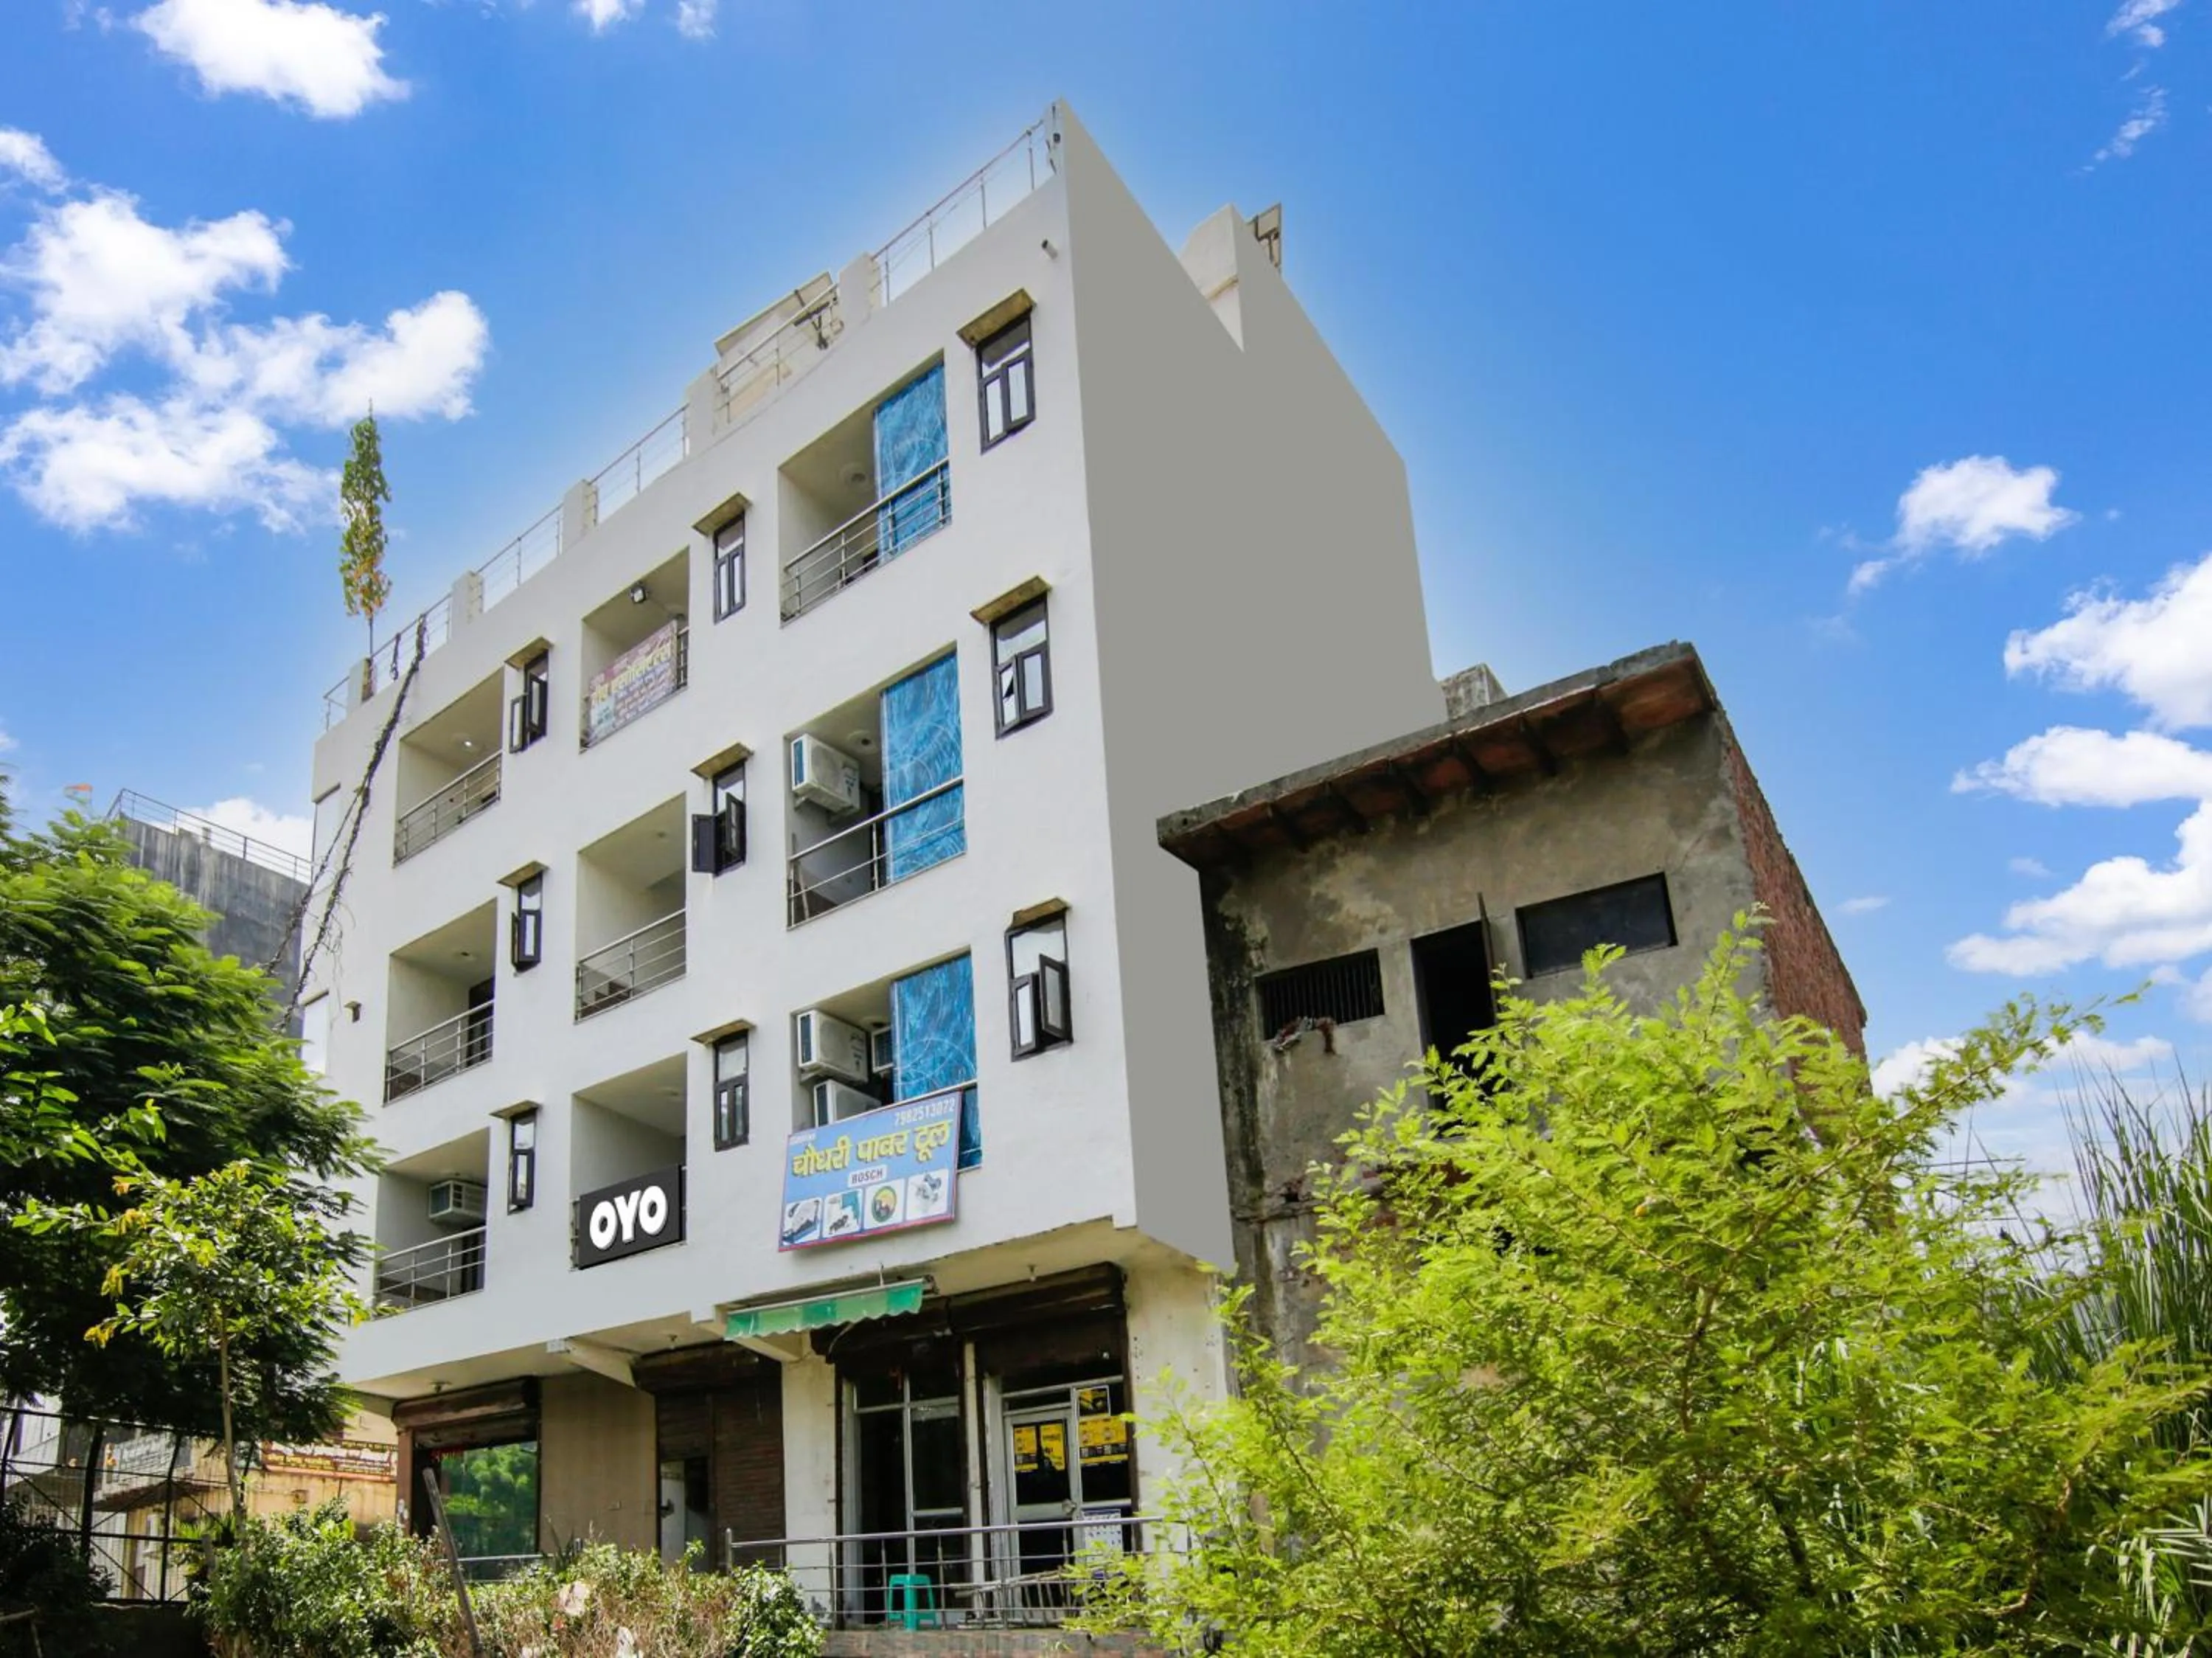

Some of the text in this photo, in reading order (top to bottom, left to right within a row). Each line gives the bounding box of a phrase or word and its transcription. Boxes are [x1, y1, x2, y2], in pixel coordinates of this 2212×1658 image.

[857, 1131, 909, 1162] पावर
[914, 1120, 952, 1162] टूल
[852, 1168, 883, 1184] BOSCH
[590, 1185, 668, 1250] OYO
